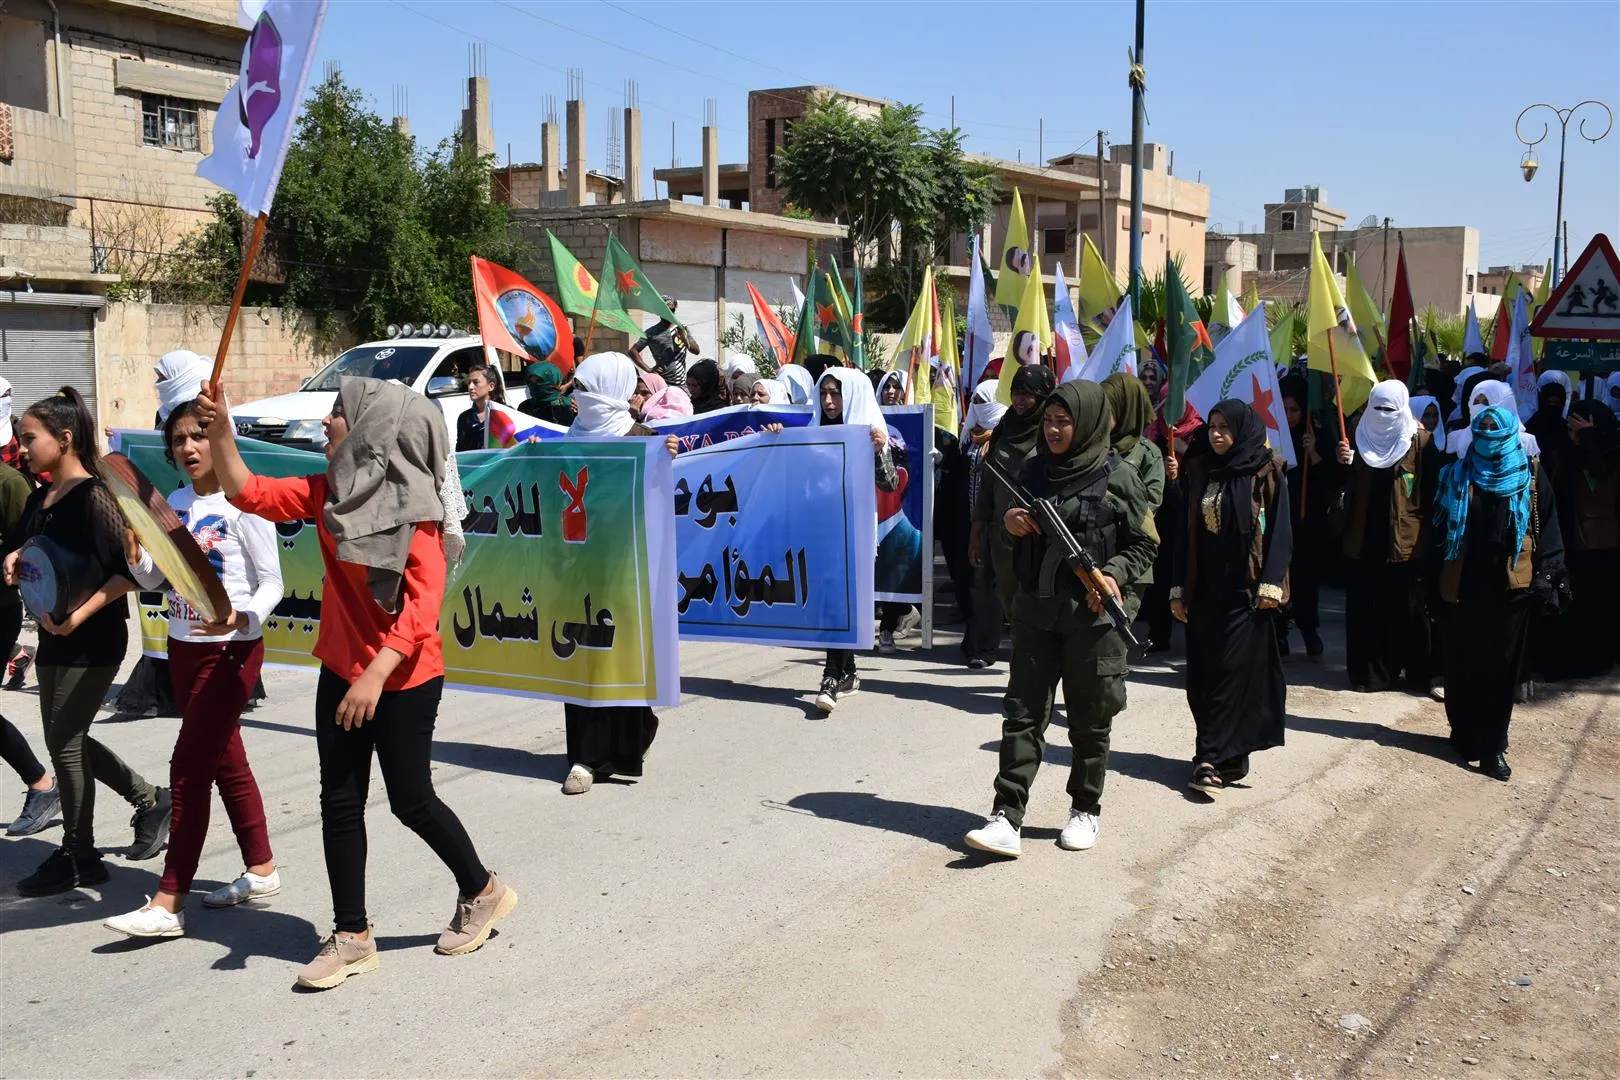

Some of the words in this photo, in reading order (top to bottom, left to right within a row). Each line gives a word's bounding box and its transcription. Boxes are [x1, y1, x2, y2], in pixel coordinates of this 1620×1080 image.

[460, 481, 543, 538] للاحت
[559, 465, 589, 544] لا
[677, 544, 809, 619] المؤامر
[453, 584, 539, 649] شمال
[550, 592, 616, 661] على
